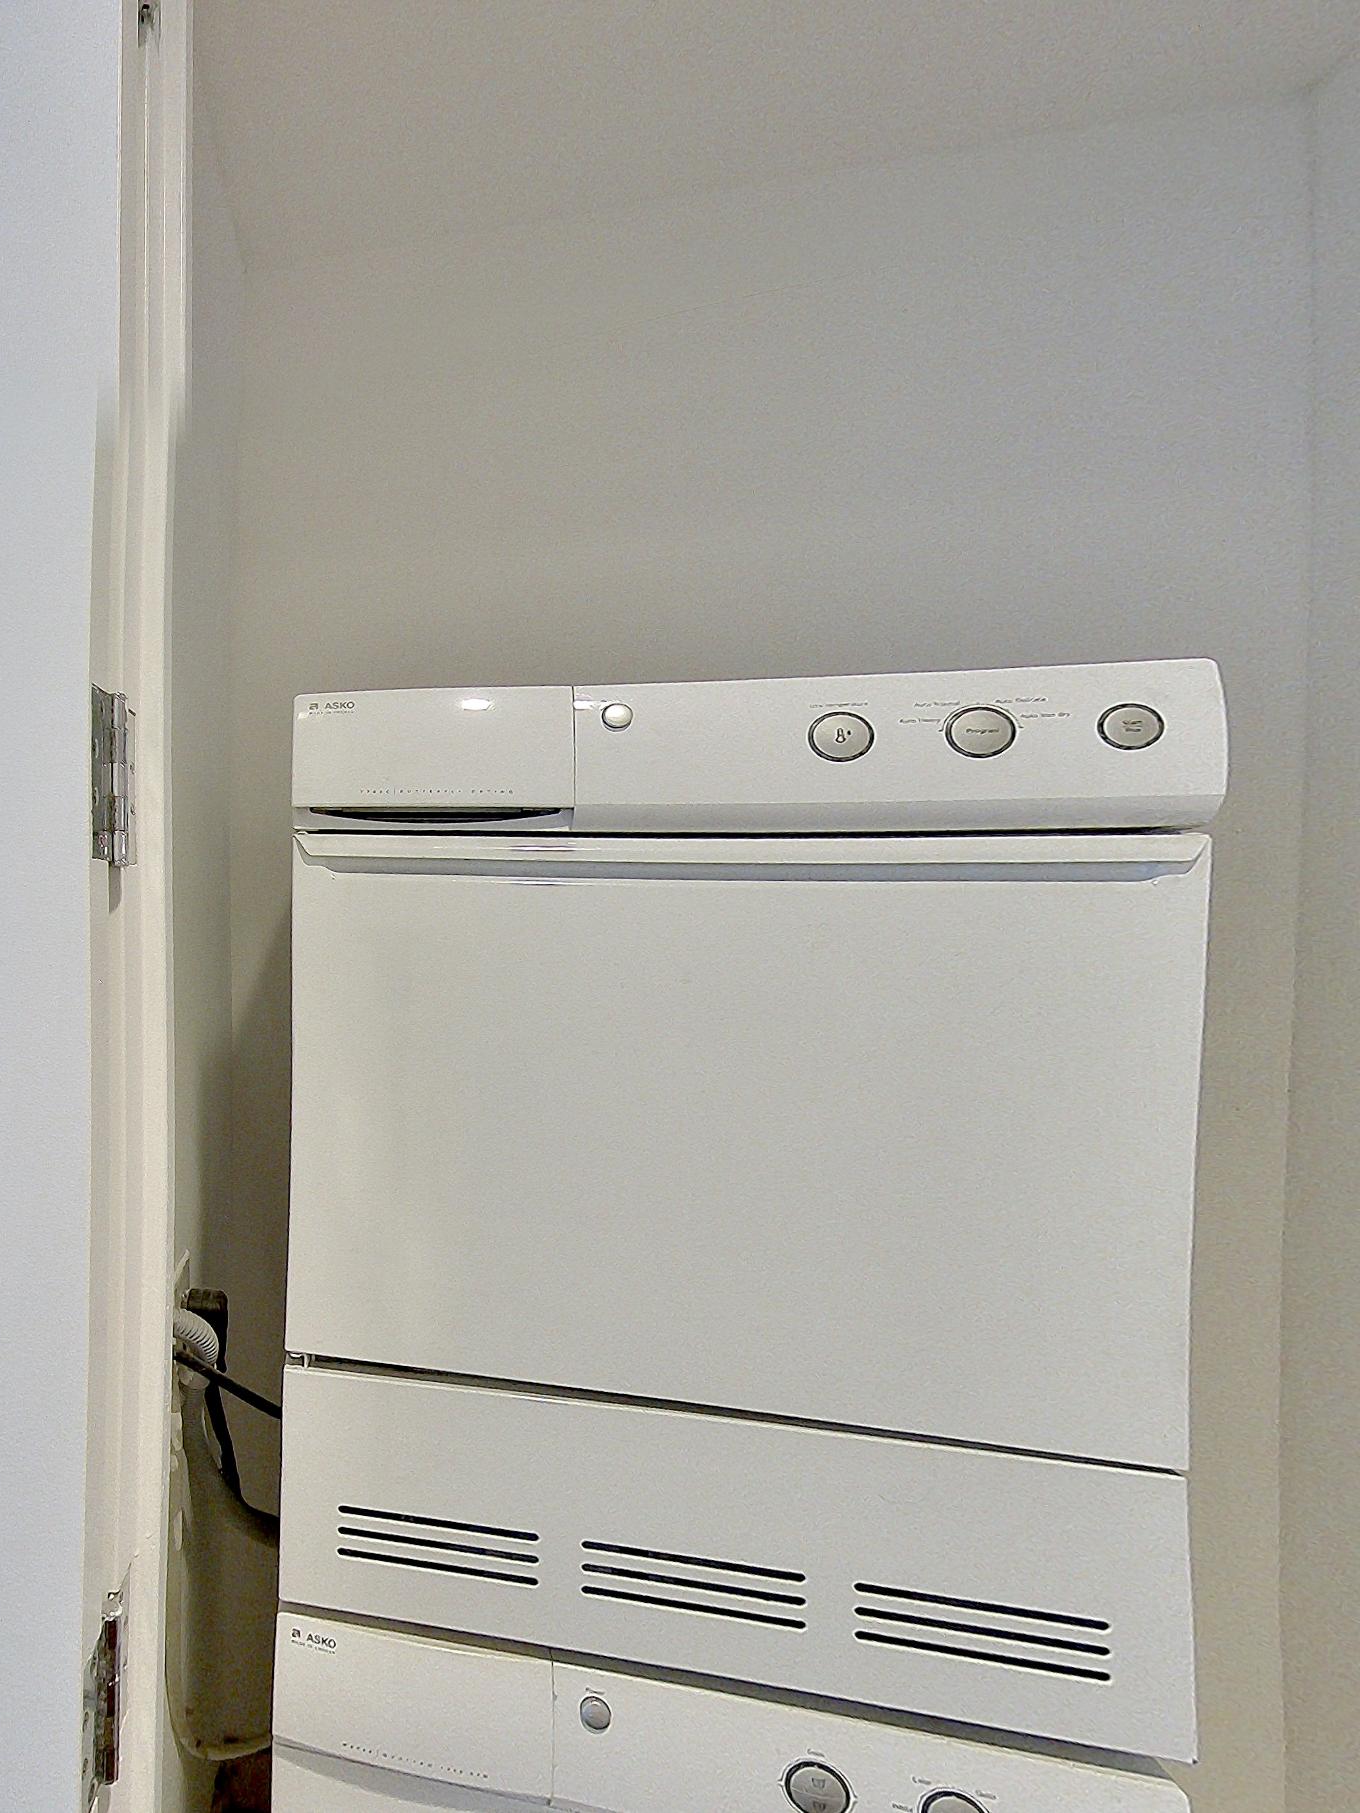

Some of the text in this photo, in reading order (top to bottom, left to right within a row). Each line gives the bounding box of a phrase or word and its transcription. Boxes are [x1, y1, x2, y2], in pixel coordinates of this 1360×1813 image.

[324, 701, 355, 710] ASKO
[965, 728, 1000, 736] Program
[306, 1633, 336, 1649] ASKO
